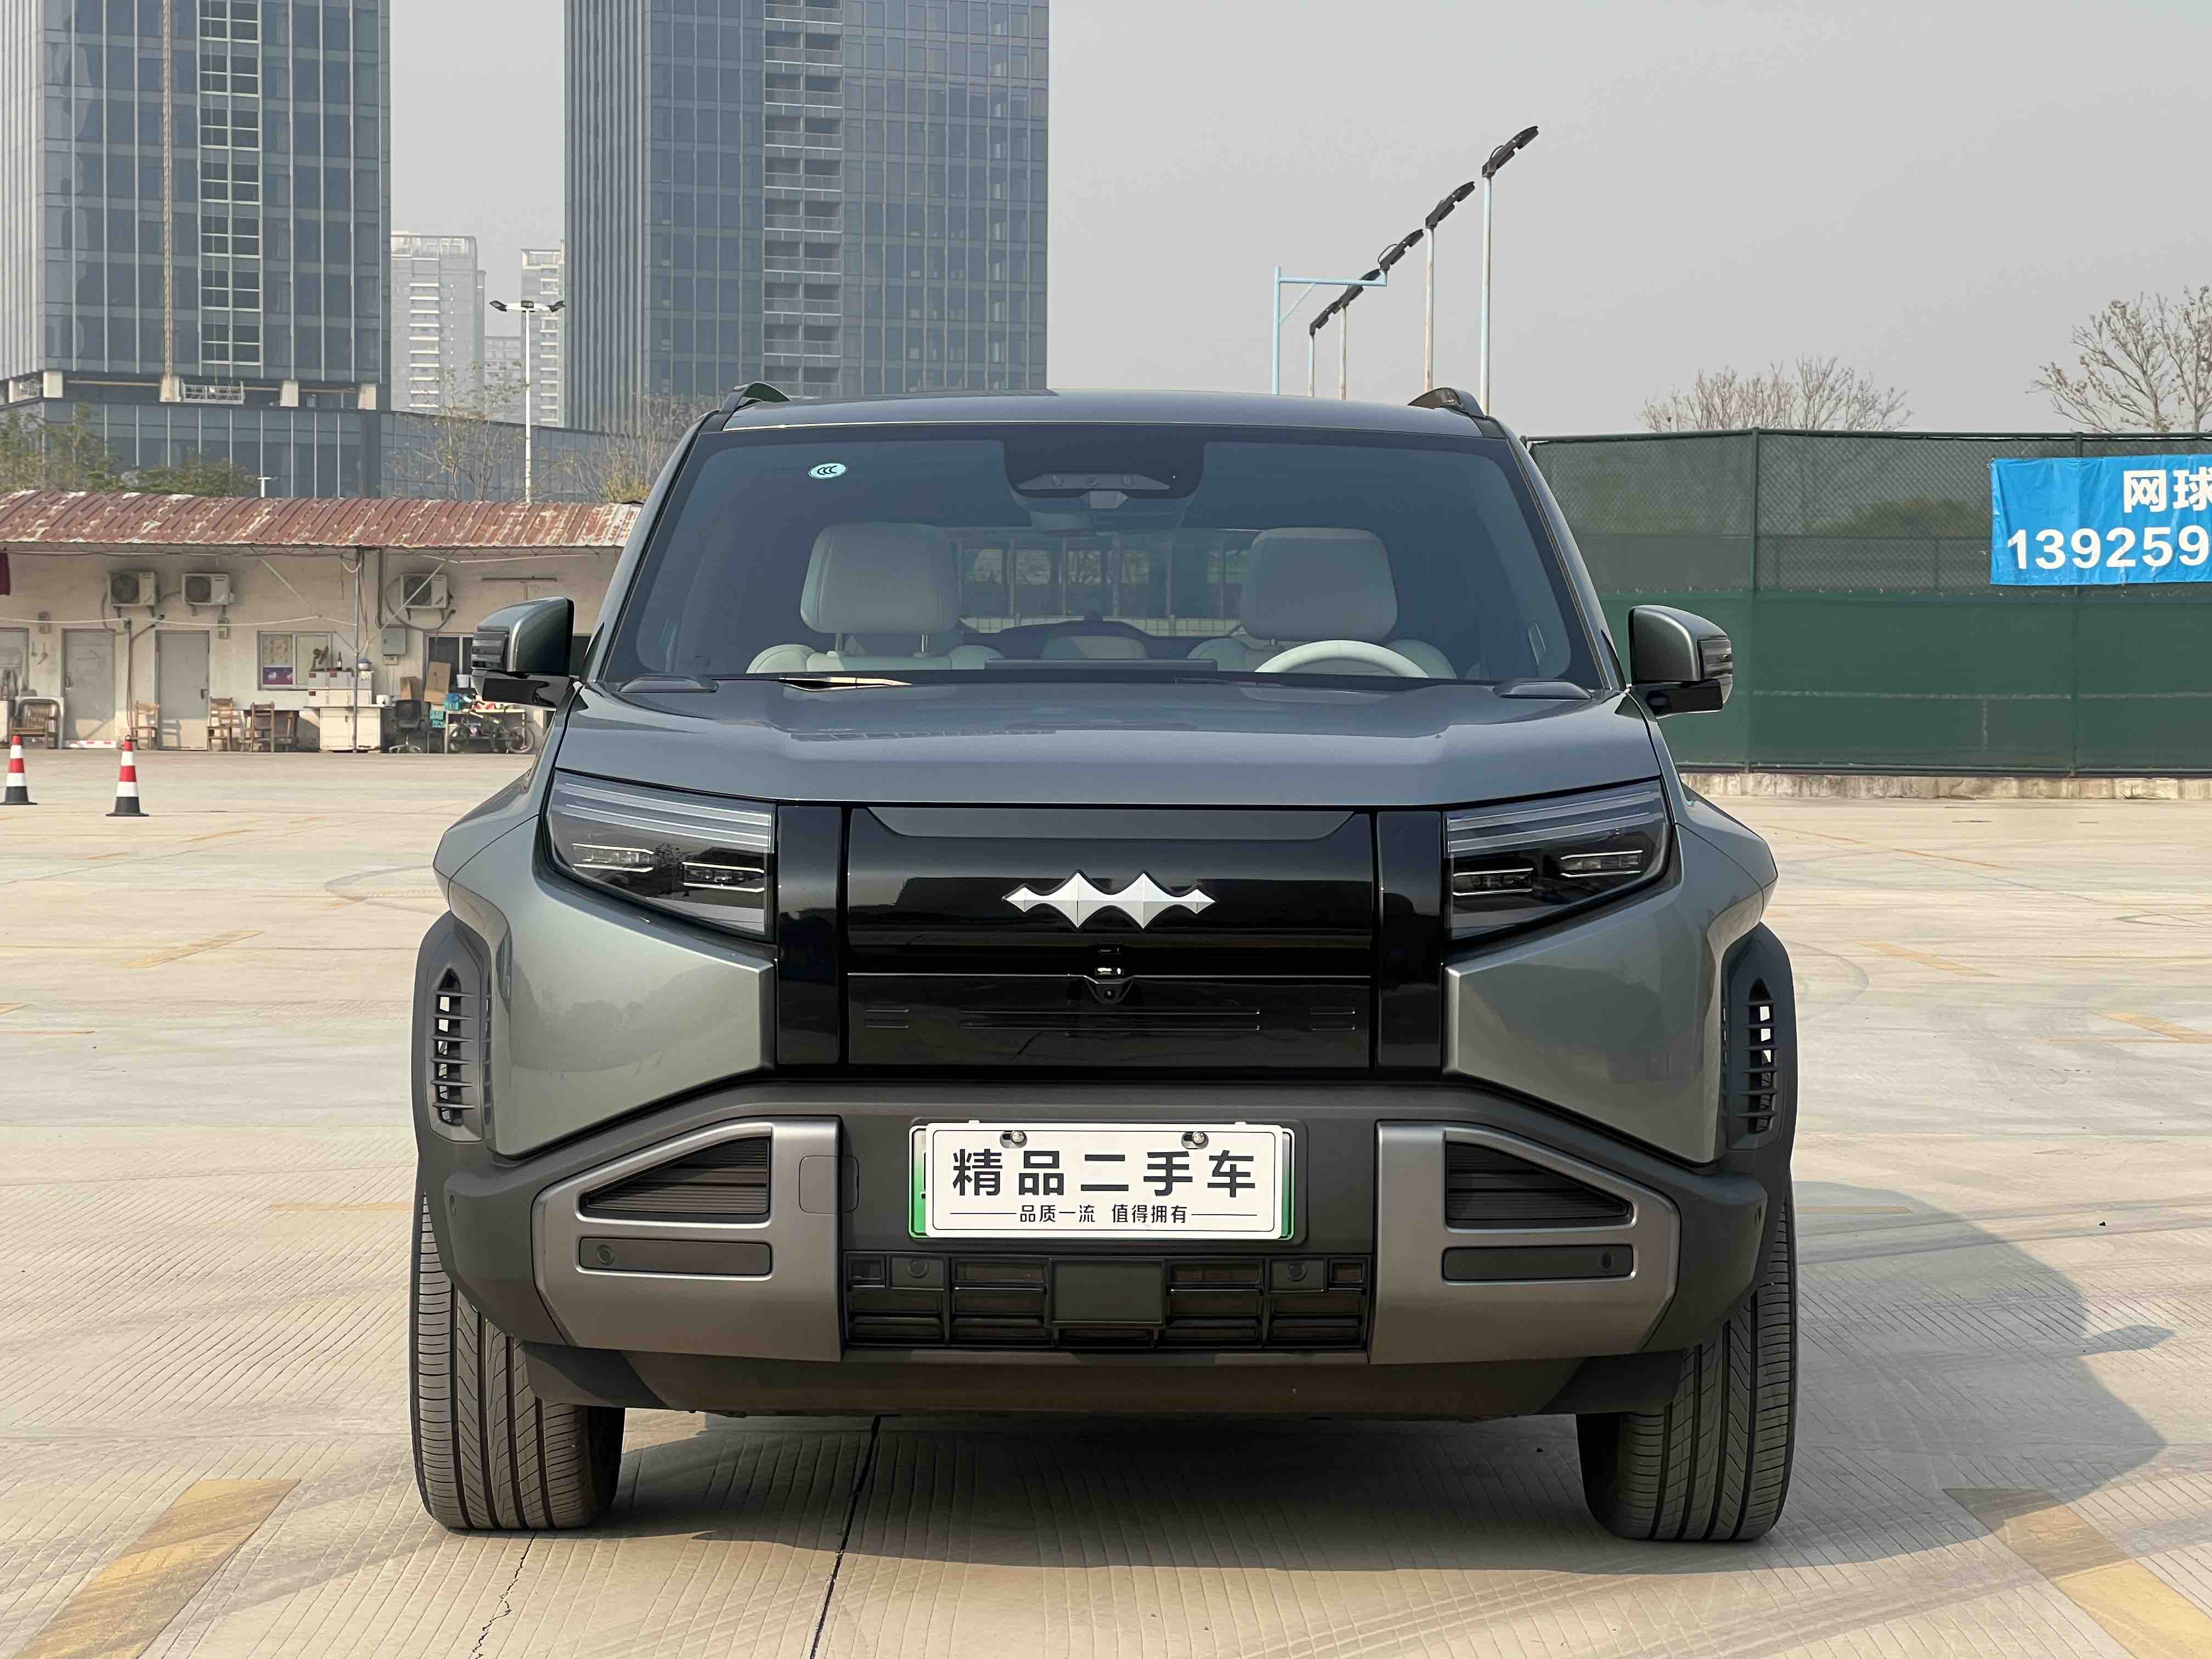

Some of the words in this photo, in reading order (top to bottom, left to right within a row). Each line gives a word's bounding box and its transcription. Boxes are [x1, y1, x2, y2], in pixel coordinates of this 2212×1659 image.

[817, 465, 838, 475] CCC
[2124, 466, 2212, 513] 网球
[2007, 524, 2209, 570] 139259
[952, 1148, 1256, 1198] 精品二手车
[1019, 1204, 1096, 1223] 品质一流
[1111, 1204, 1188, 1224] 值得拥有
